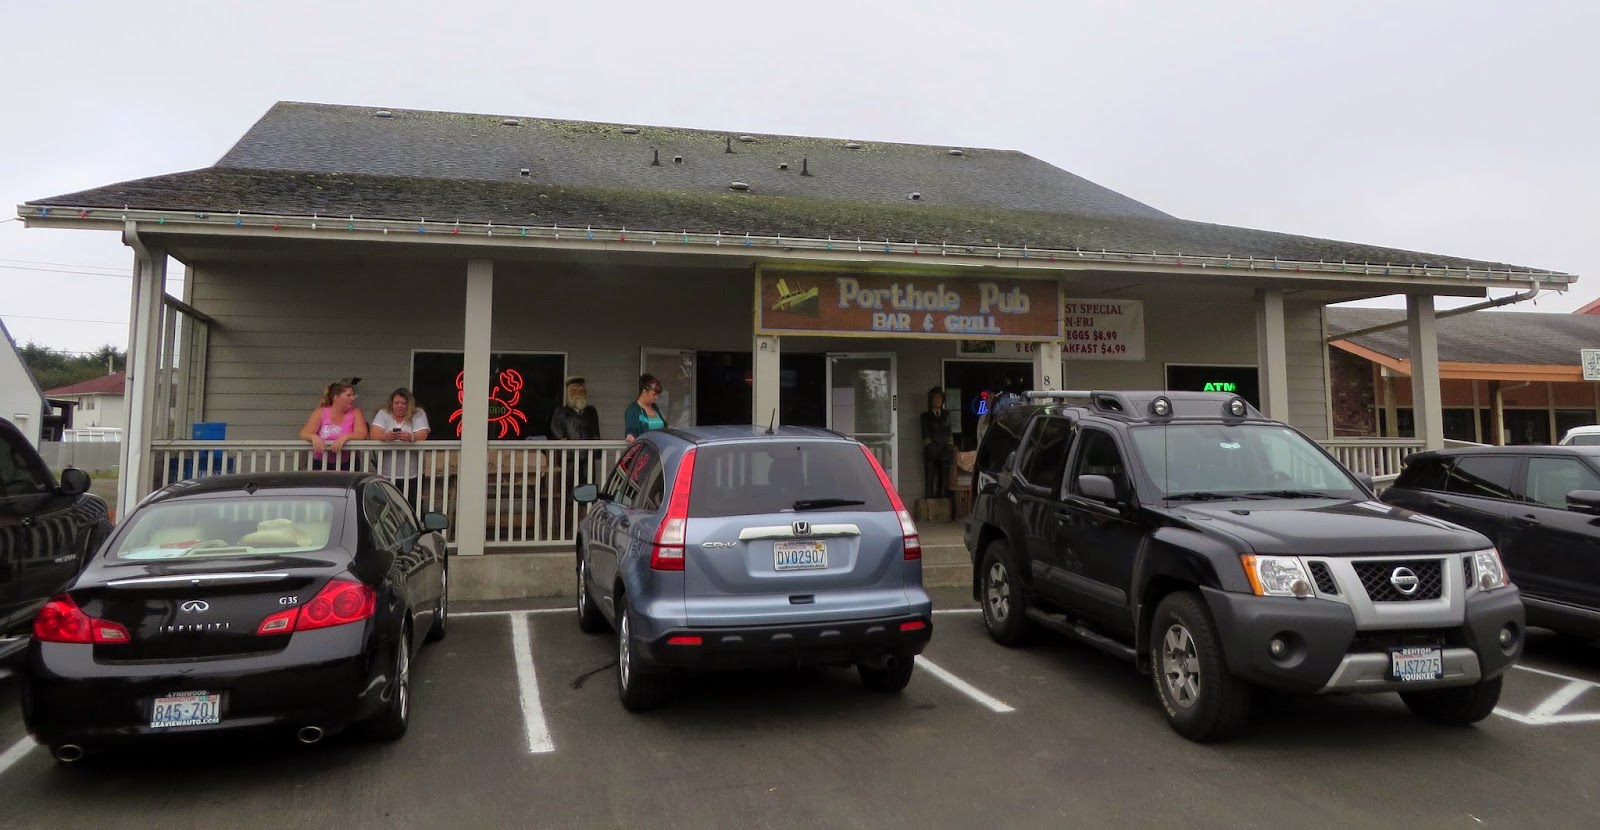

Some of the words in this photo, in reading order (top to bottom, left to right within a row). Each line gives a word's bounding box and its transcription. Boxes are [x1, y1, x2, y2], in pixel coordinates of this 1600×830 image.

[836, 277, 961, 312] Porthole
[978, 282, 1031, 314] Pub
[1064, 303, 1077, 314] ST
[1080, 304, 1123, 315] SPECIAL
[872, 312, 911, 331] BAR
[922, 313, 934, 332] &
[943, 314, 1001, 334] GRILL
[1064, 317, 1094, 327] N-FRI
[1066, 330, 1090, 340] EGGS
[1093, 330, 1118, 341] $8.99
[1060, 344, 1098, 353] AKFAST
[1101, 344, 1126, 355] $4.99
[1043, 375, 1051, 386] 8
[1203, 382, 1236, 392] ATM
[279, 596, 298, 605] G35
[159, 622, 230, 633] INFINITI
[150, 718, 220, 728] SEAVIEWAUTO.COM
